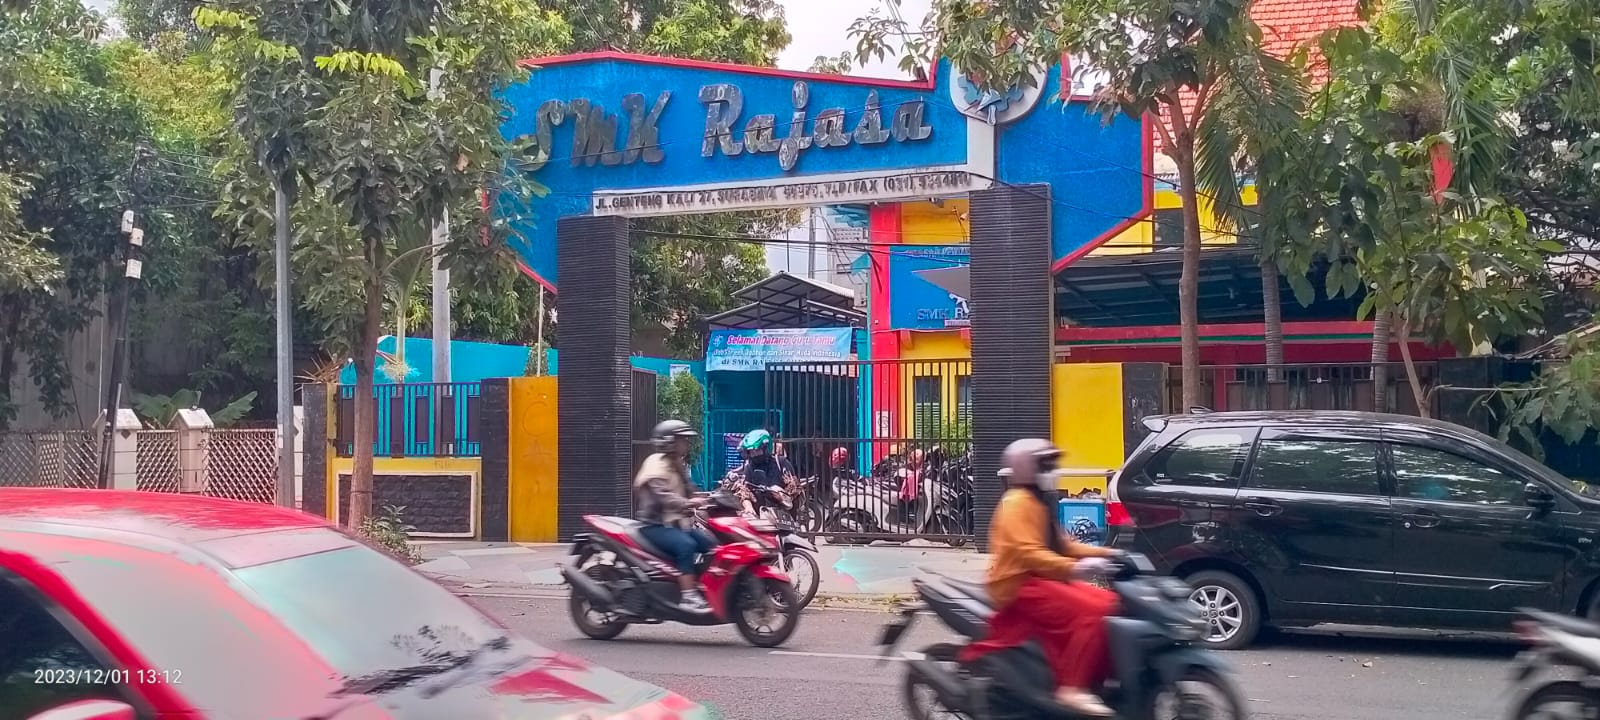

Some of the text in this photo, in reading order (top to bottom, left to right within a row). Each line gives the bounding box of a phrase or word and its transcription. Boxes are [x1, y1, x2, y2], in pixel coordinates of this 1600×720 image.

[512, 81, 932, 171] SMK Rajasa
[667, 192, 694, 206] KALI
[917, 309, 949, 320] SMK
[727, 334, 760, 346] Selamat
